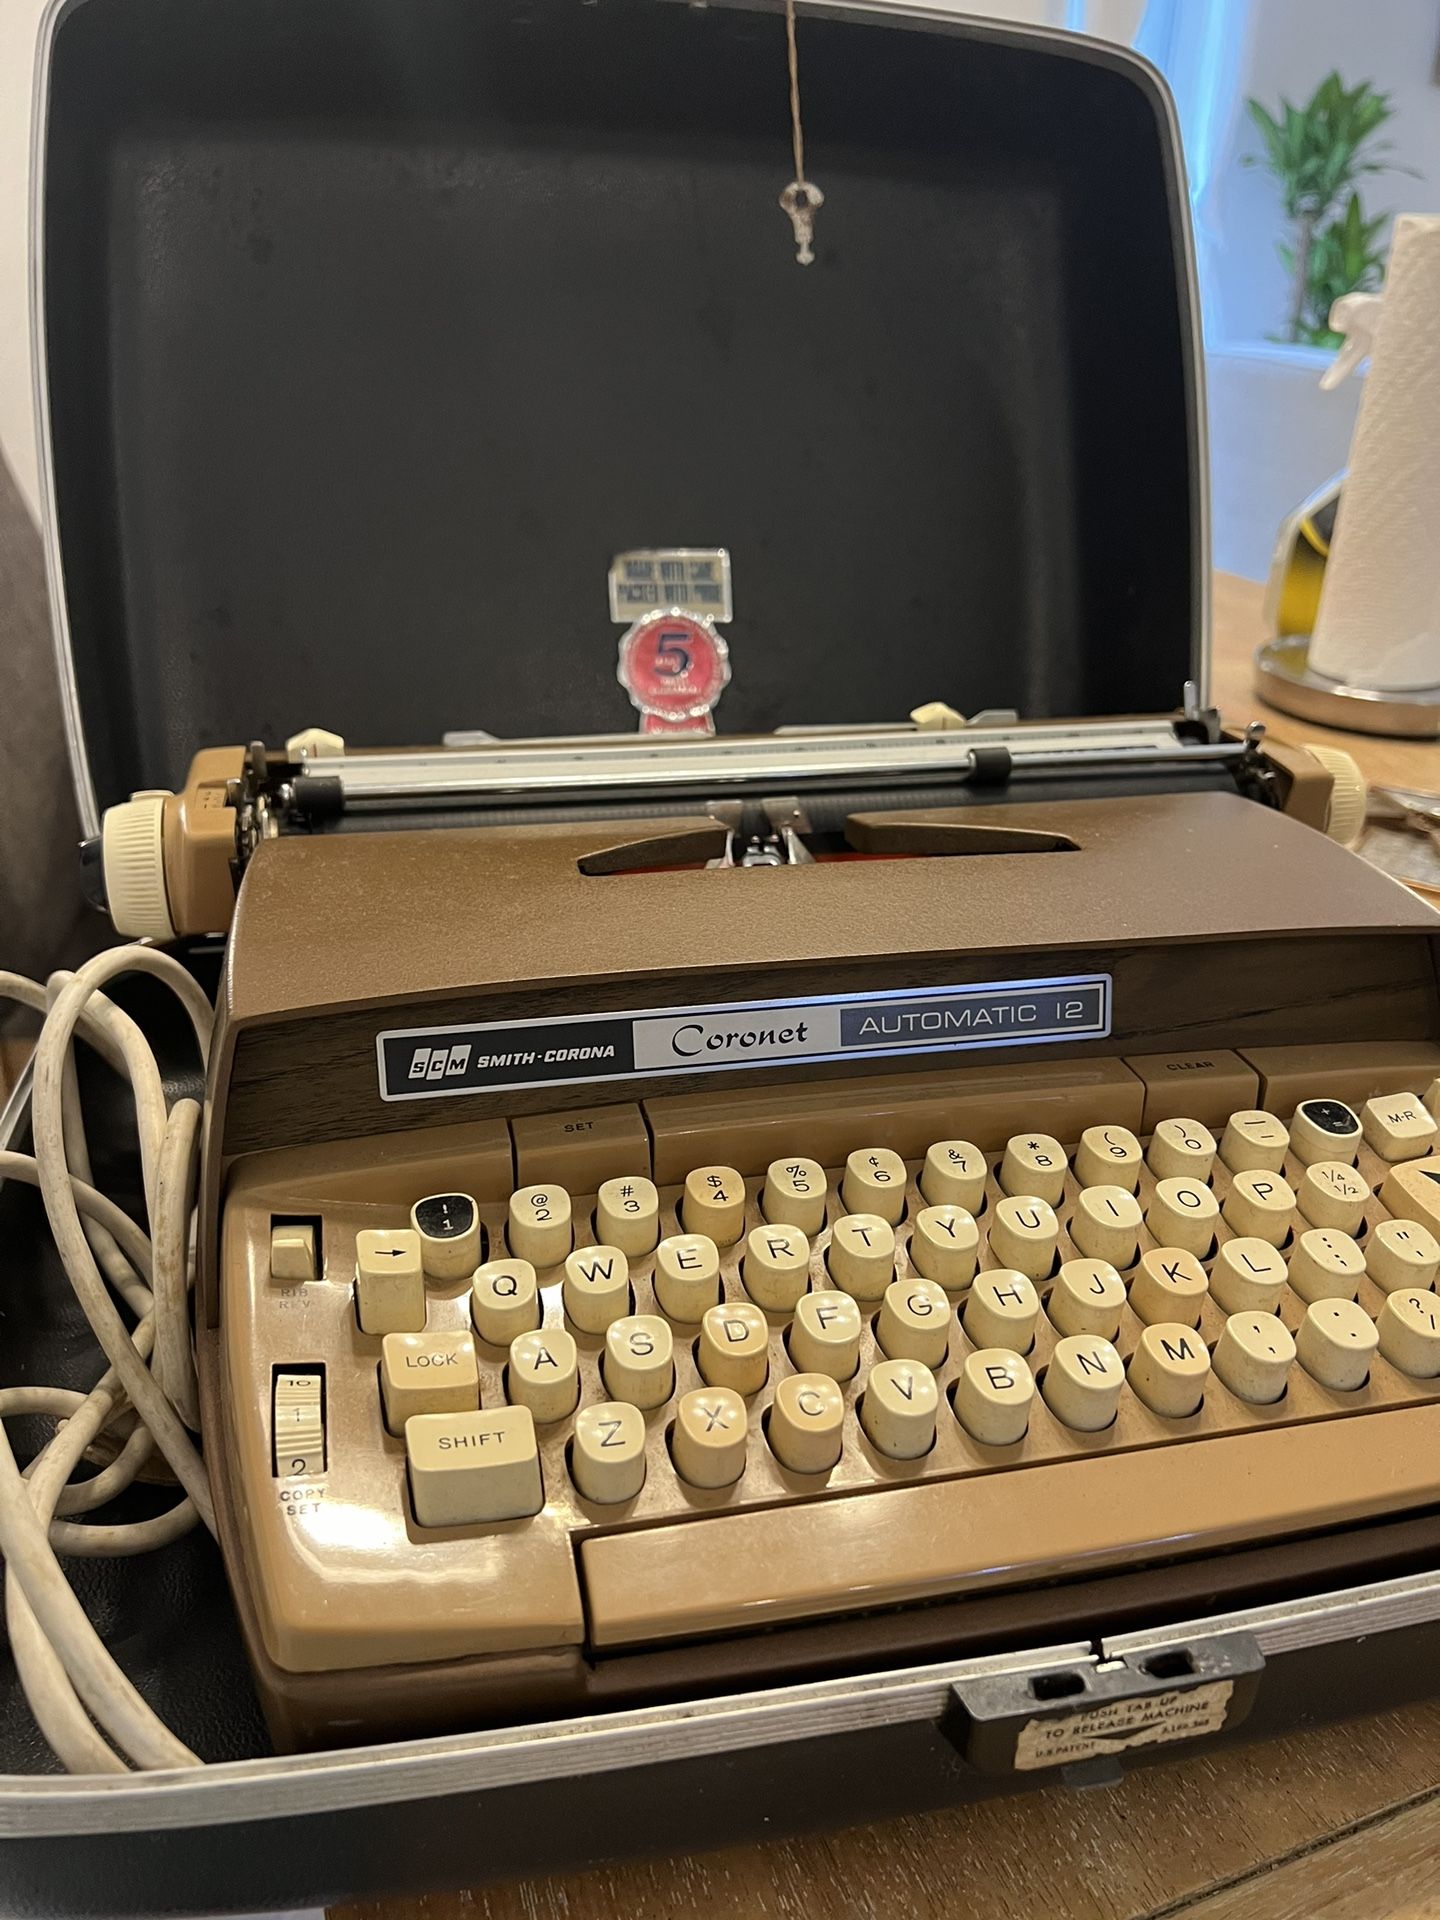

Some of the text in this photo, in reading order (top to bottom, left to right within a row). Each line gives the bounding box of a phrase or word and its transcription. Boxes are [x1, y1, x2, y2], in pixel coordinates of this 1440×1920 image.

[654, 633, 690, 677] 5
[672, 1021, 809, 1057] Coronet
[858, 1003, 1037, 1036] AUTOMATIC
[1056, 1000, 1084, 1020] 12
[1165, 1060, 1216, 1071] CLEAR
[563, 1120, 595, 1133] SET
[1173, 1125, 1187, 1139] )
[1103, 1131, 1116, 1146] (
[947, 1148, 963, 1160] &
[1035, 1154, 1053, 1166] 8
[1109, 1146, 1127, 1158] 9
[785, 1164, 807, 1179] %
[873, 1170, 891, 1182] 6
[952, 1160, 967, 1173] 7
[620, 1185, 634, 1197] #
[706, 1175, 722, 1188] $
[794, 1179, 810, 1192] 5
[1251, 1182, 1274, 1200] P
[530, 1193, 549, 1207] @
[712, 1189, 729, 1202] 4
[1176, 1189, 1202, 1208] O
[442, 1203, 449, 1214] !
[535, 1209, 552, 1222] 2
[623, 1200, 640, 1212] 3
[442, 1219, 454, 1231] 1
[935, 1217, 956, 1238] Y
[1014, 1208, 1041, 1229] U
[851, 1226, 873, 1247] T
[766, 1238, 795, 1258] R
[676, 1247, 703, 1270] E
[1240, 1253, 1272, 1273] L
[577, 1258, 614, 1283] W
[1161, 1261, 1193, 1284] K
[280, 1287, 309, 1297] RIB
[492, 1275, 518, 1297] Q
[1089, 1273, 1106, 1295] J
[906, 1293, 933, 1316] G
[992, 1283, 1024, 1307] H
[1409, 1297, 1425, 1314] ?
[815, 1305, 839, 1330] F
[722, 1318, 750, 1343] D
[628, 1331, 655, 1356] S
[1159, 1337, 1196, 1361] M
[405, 1352, 459, 1368] LOCK
[534, 1347, 559, 1371] A
[1075, 1350, 1108, 1376] N
[984, 1365, 1015, 1390] B
[890, 1375, 914, 1401] V
[797, 1390, 826, 1417] C
[700, 1404, 730, 1432] X
[438, 1431, 506, 1450] SHIFT
[597, 1419, 626, 1447] Z
[291, 1458, 307, 1476] 2
[280, 1487, 326, 1502] COPY
[286, 1503, 322, 1516] SET
[1046, 1701, 1209, 1739] TO RELEASE MACHINE
